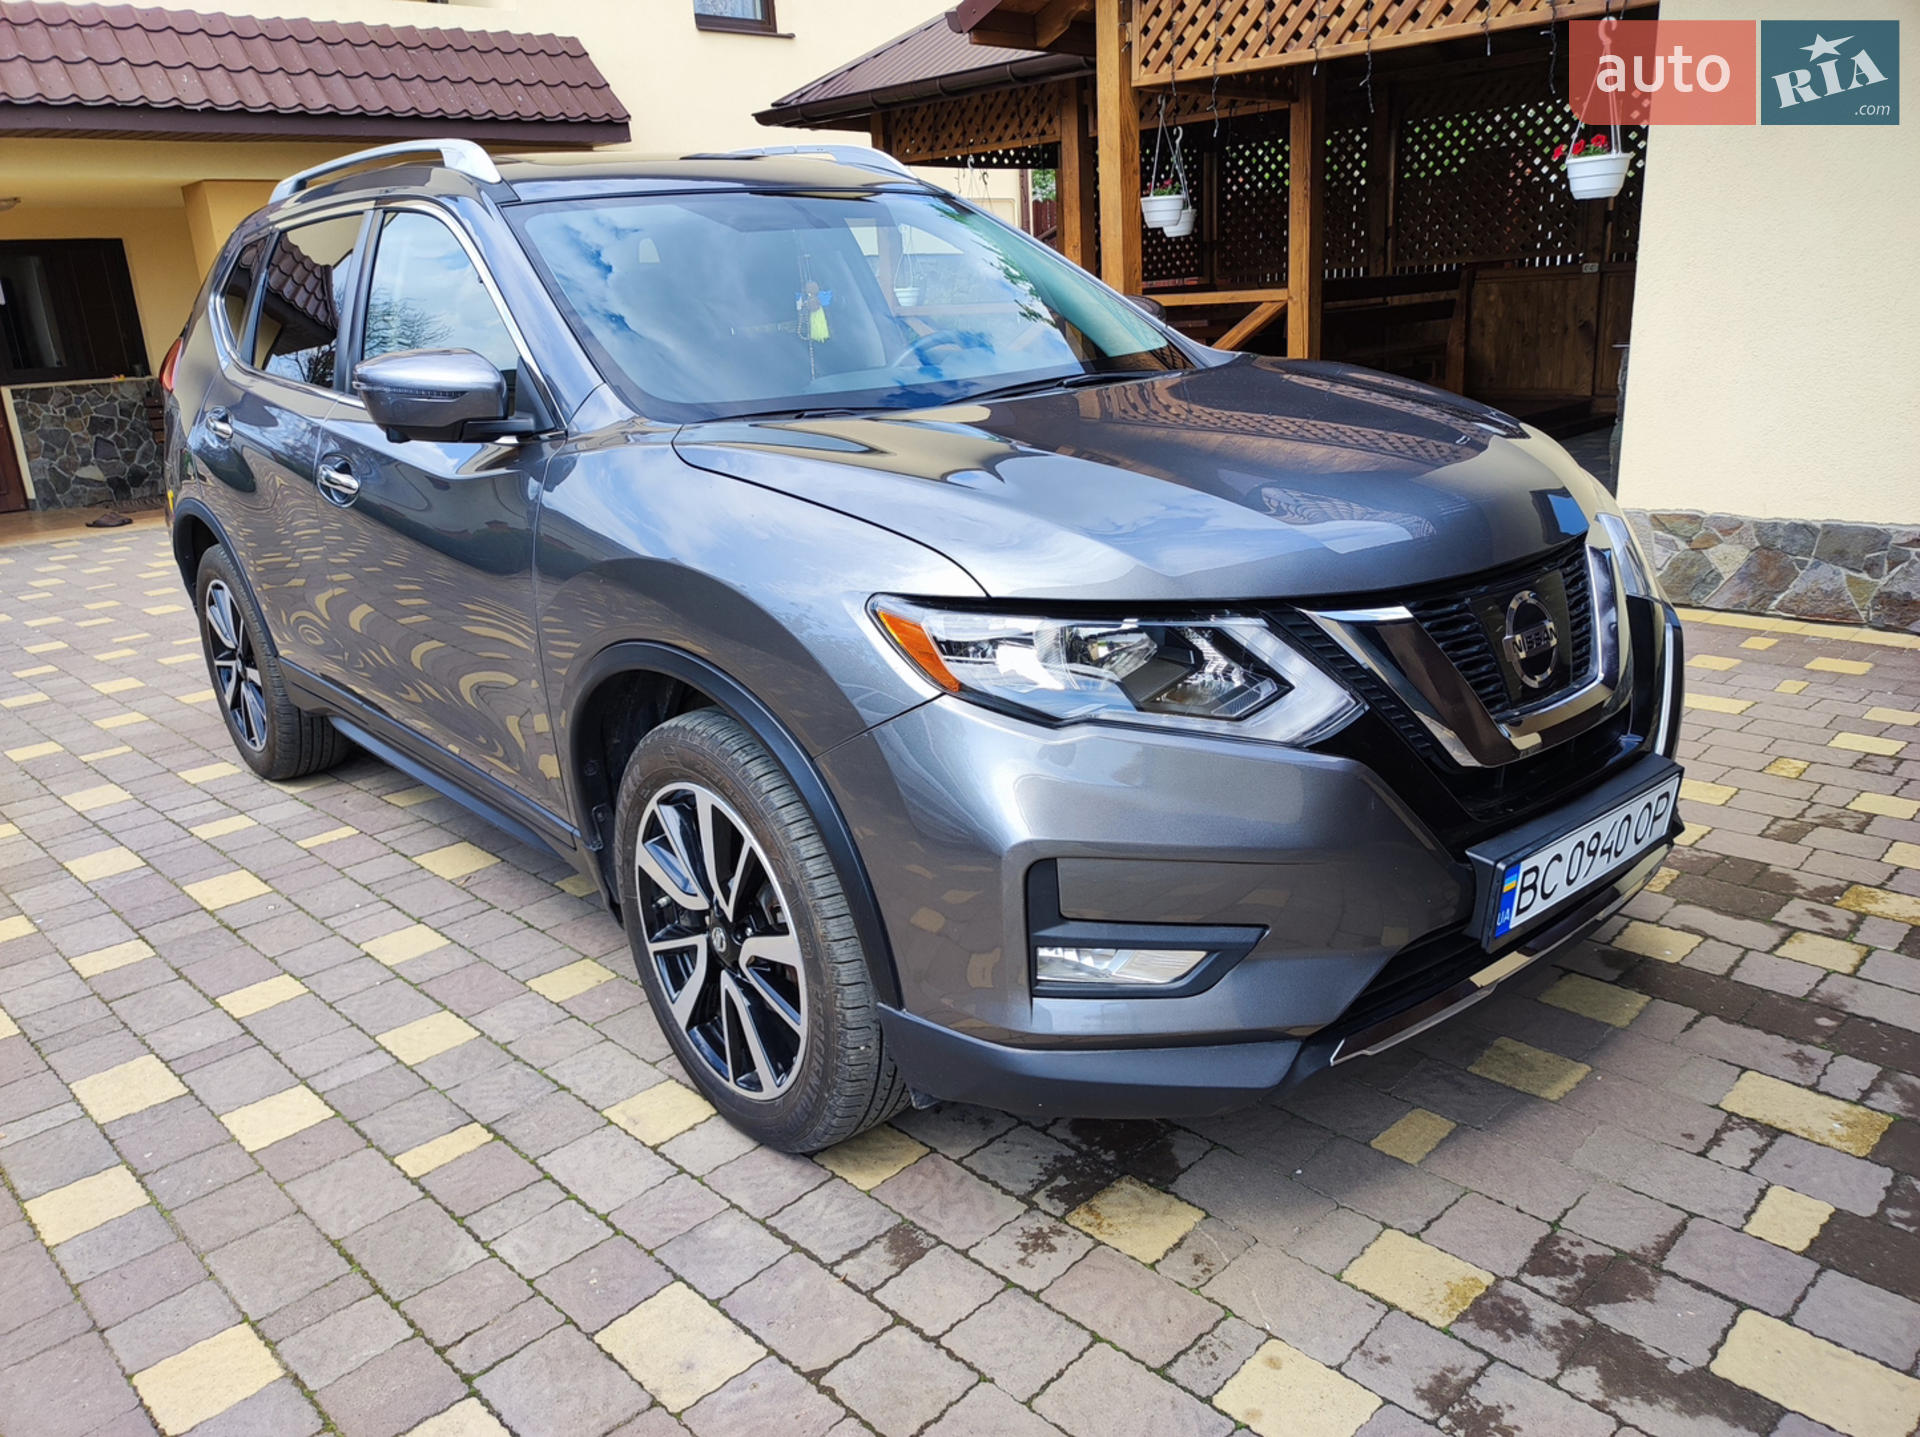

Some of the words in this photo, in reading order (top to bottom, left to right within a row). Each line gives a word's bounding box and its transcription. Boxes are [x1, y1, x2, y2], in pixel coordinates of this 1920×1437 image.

[1513, 626, 1558, 653] NISSAN
[1515, 853, 1563, 917] BC
[1565, 813, 1632, 886] 0940
[1634, 791, 1670, 845] OP
[1497, 907, 1511, 926] UA
